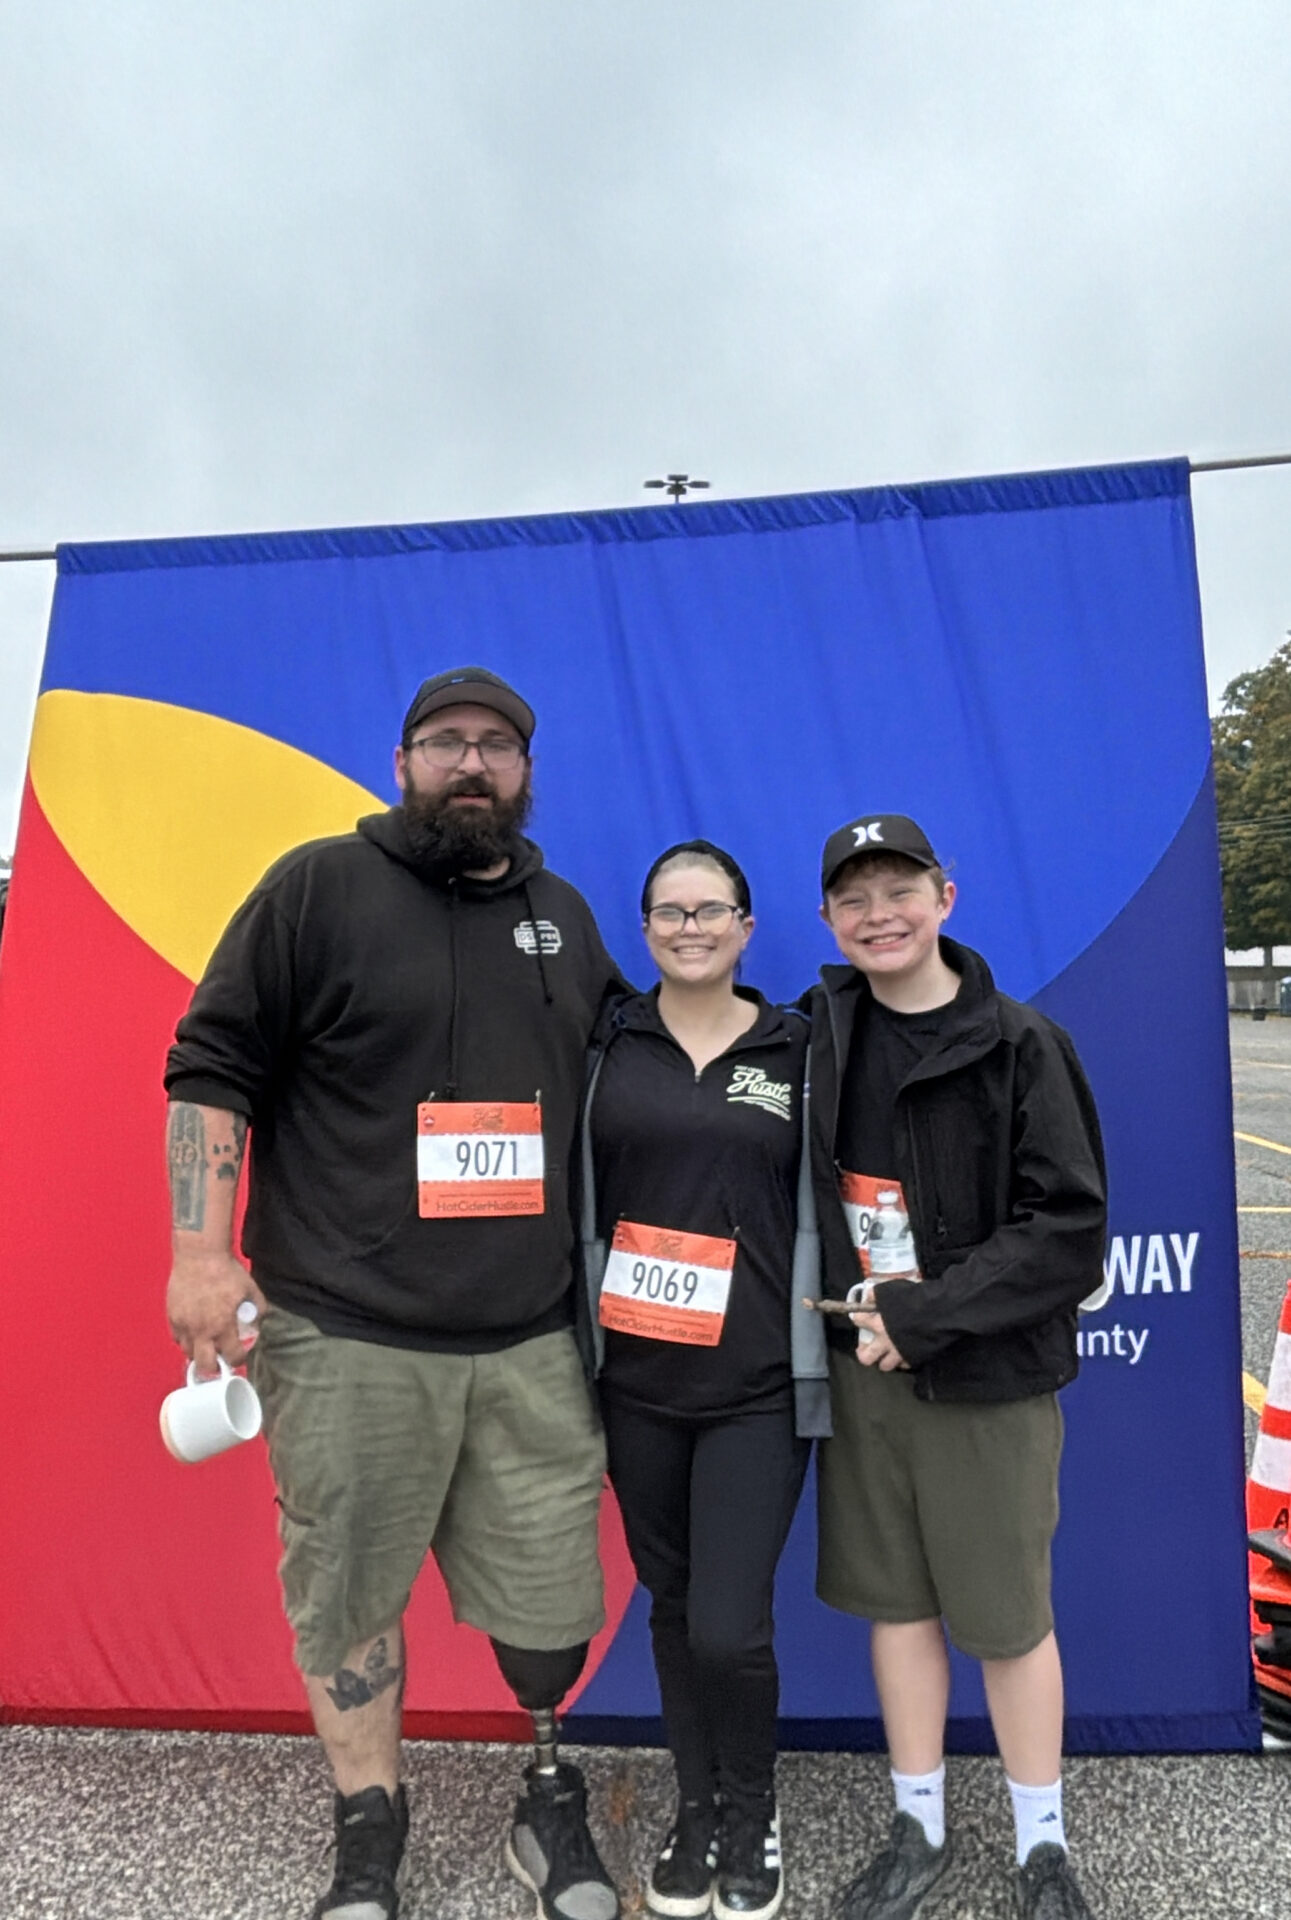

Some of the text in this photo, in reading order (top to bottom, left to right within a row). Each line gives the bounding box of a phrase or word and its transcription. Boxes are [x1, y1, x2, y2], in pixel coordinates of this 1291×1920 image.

[456, 1140, 518, 1177] 9071
[436, 1199, 539, 1212] HotCiderHustle.com
[1106, 1232, 1200, 1296] WAY
[632, 1261, 699, 1305] 9069
[609, 1314, 714, 1342] HotCiderHustle.com
